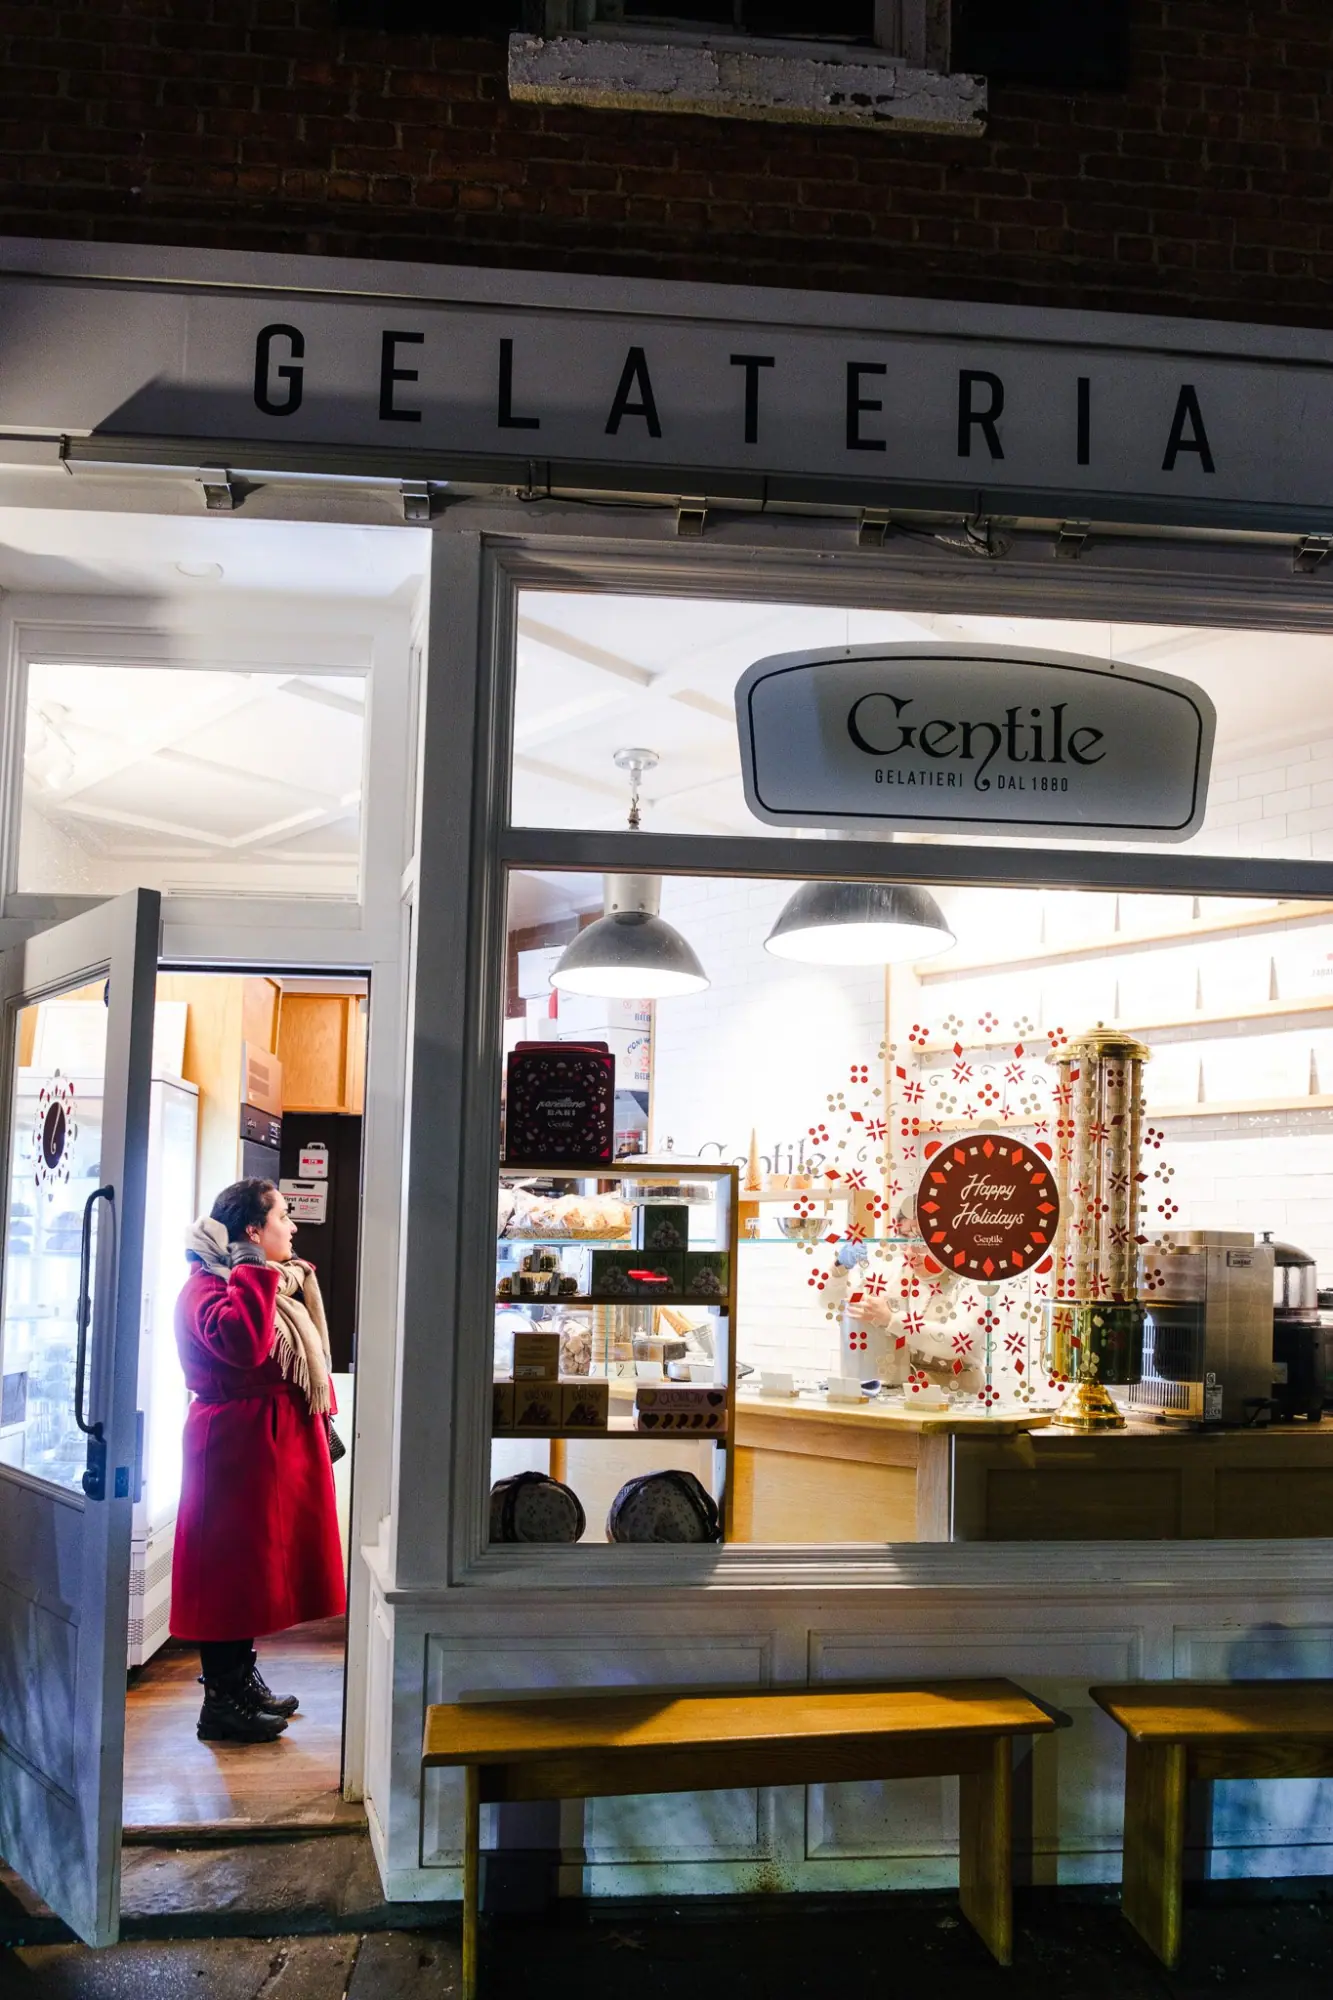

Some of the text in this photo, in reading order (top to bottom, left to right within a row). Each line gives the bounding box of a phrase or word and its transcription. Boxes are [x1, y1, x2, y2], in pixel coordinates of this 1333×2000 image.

[253, 322, 1216, 474] GELATERIA
[847, 692, 1107, 792] Gentile
[875, 769, 1069, 792] GELATIERI DAL 1880
[960, 1173, 1017, 1201] Happy
[952, 1202, 1025, 1230] Holidays
[973, 1234, 1003, 1247] Gentile
